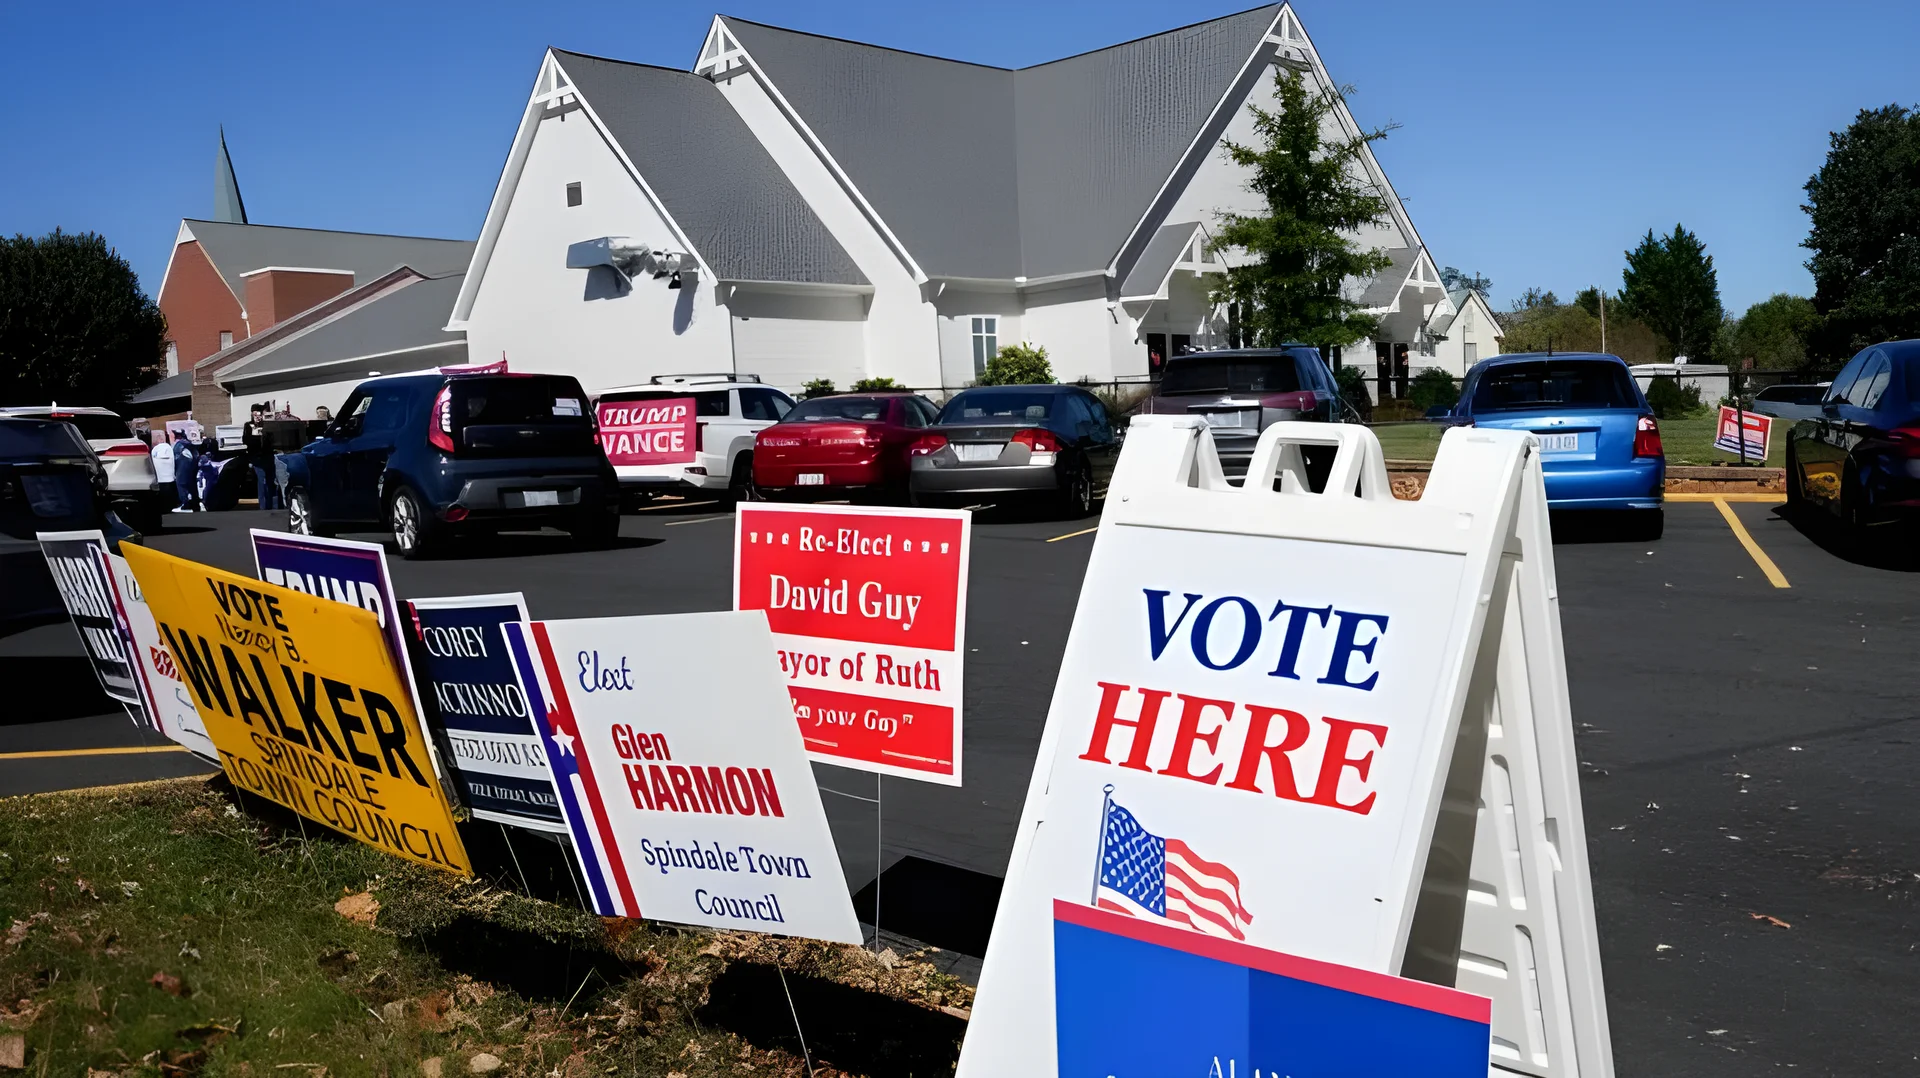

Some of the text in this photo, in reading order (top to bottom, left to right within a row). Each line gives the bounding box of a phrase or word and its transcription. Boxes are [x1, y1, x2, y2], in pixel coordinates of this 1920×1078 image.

[604, 405, 687, 426] TRUMP
[601, 430, 685, 455] VANCE
[206, 577, 289, 633] VOTE
[769, 574, 922, 631] David Guy
[423, 626, 488, 658] COREY
[1143, 588, 1389, 691] VOTE
[777, 649, 941, 692] ayor of Ruth
[159, 621, 430, 788] WALKER
[433, 681, 526, 718] ACKINNO
[611, 723, 672, 761] Glen
[1078, 681, 1389, 816] HERE
[250, 731, 386, 810] SPINDALE
[621, 764, 785, 818] HARMON
[217, 748, 462, 871] TOWN COUNCIL
[641, 838, 811, 879] Spindale Town
[695, 888, 785, 924] Council
